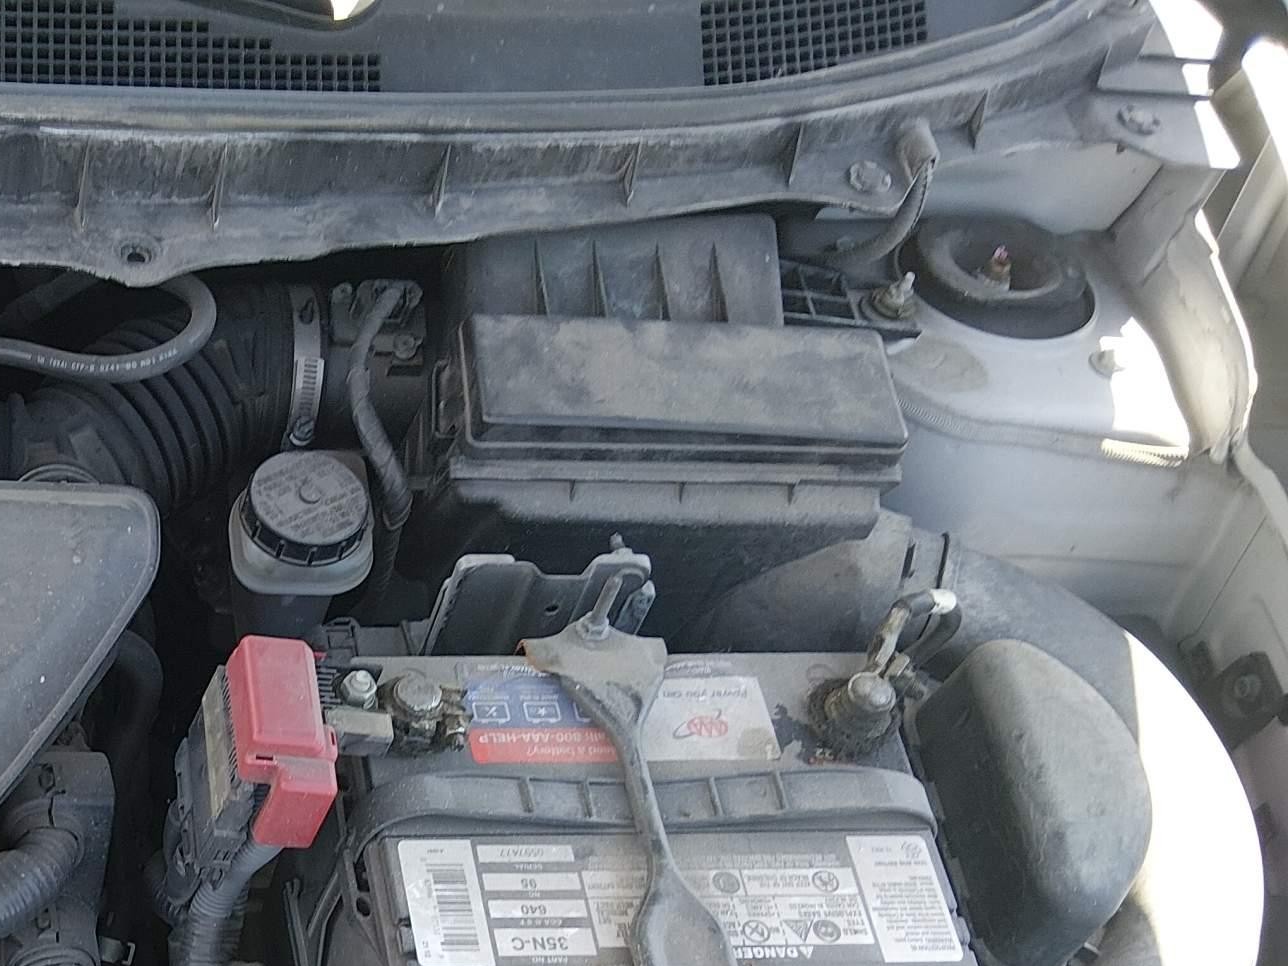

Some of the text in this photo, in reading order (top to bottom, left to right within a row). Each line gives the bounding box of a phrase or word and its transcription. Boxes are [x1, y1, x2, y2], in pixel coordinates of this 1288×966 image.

[520, 878, 537, 889] 95
[520, 903, 547, 915] 640
[511, 936, 569, 951] 35N-C
[732, 945, 799, 960] DANGER
